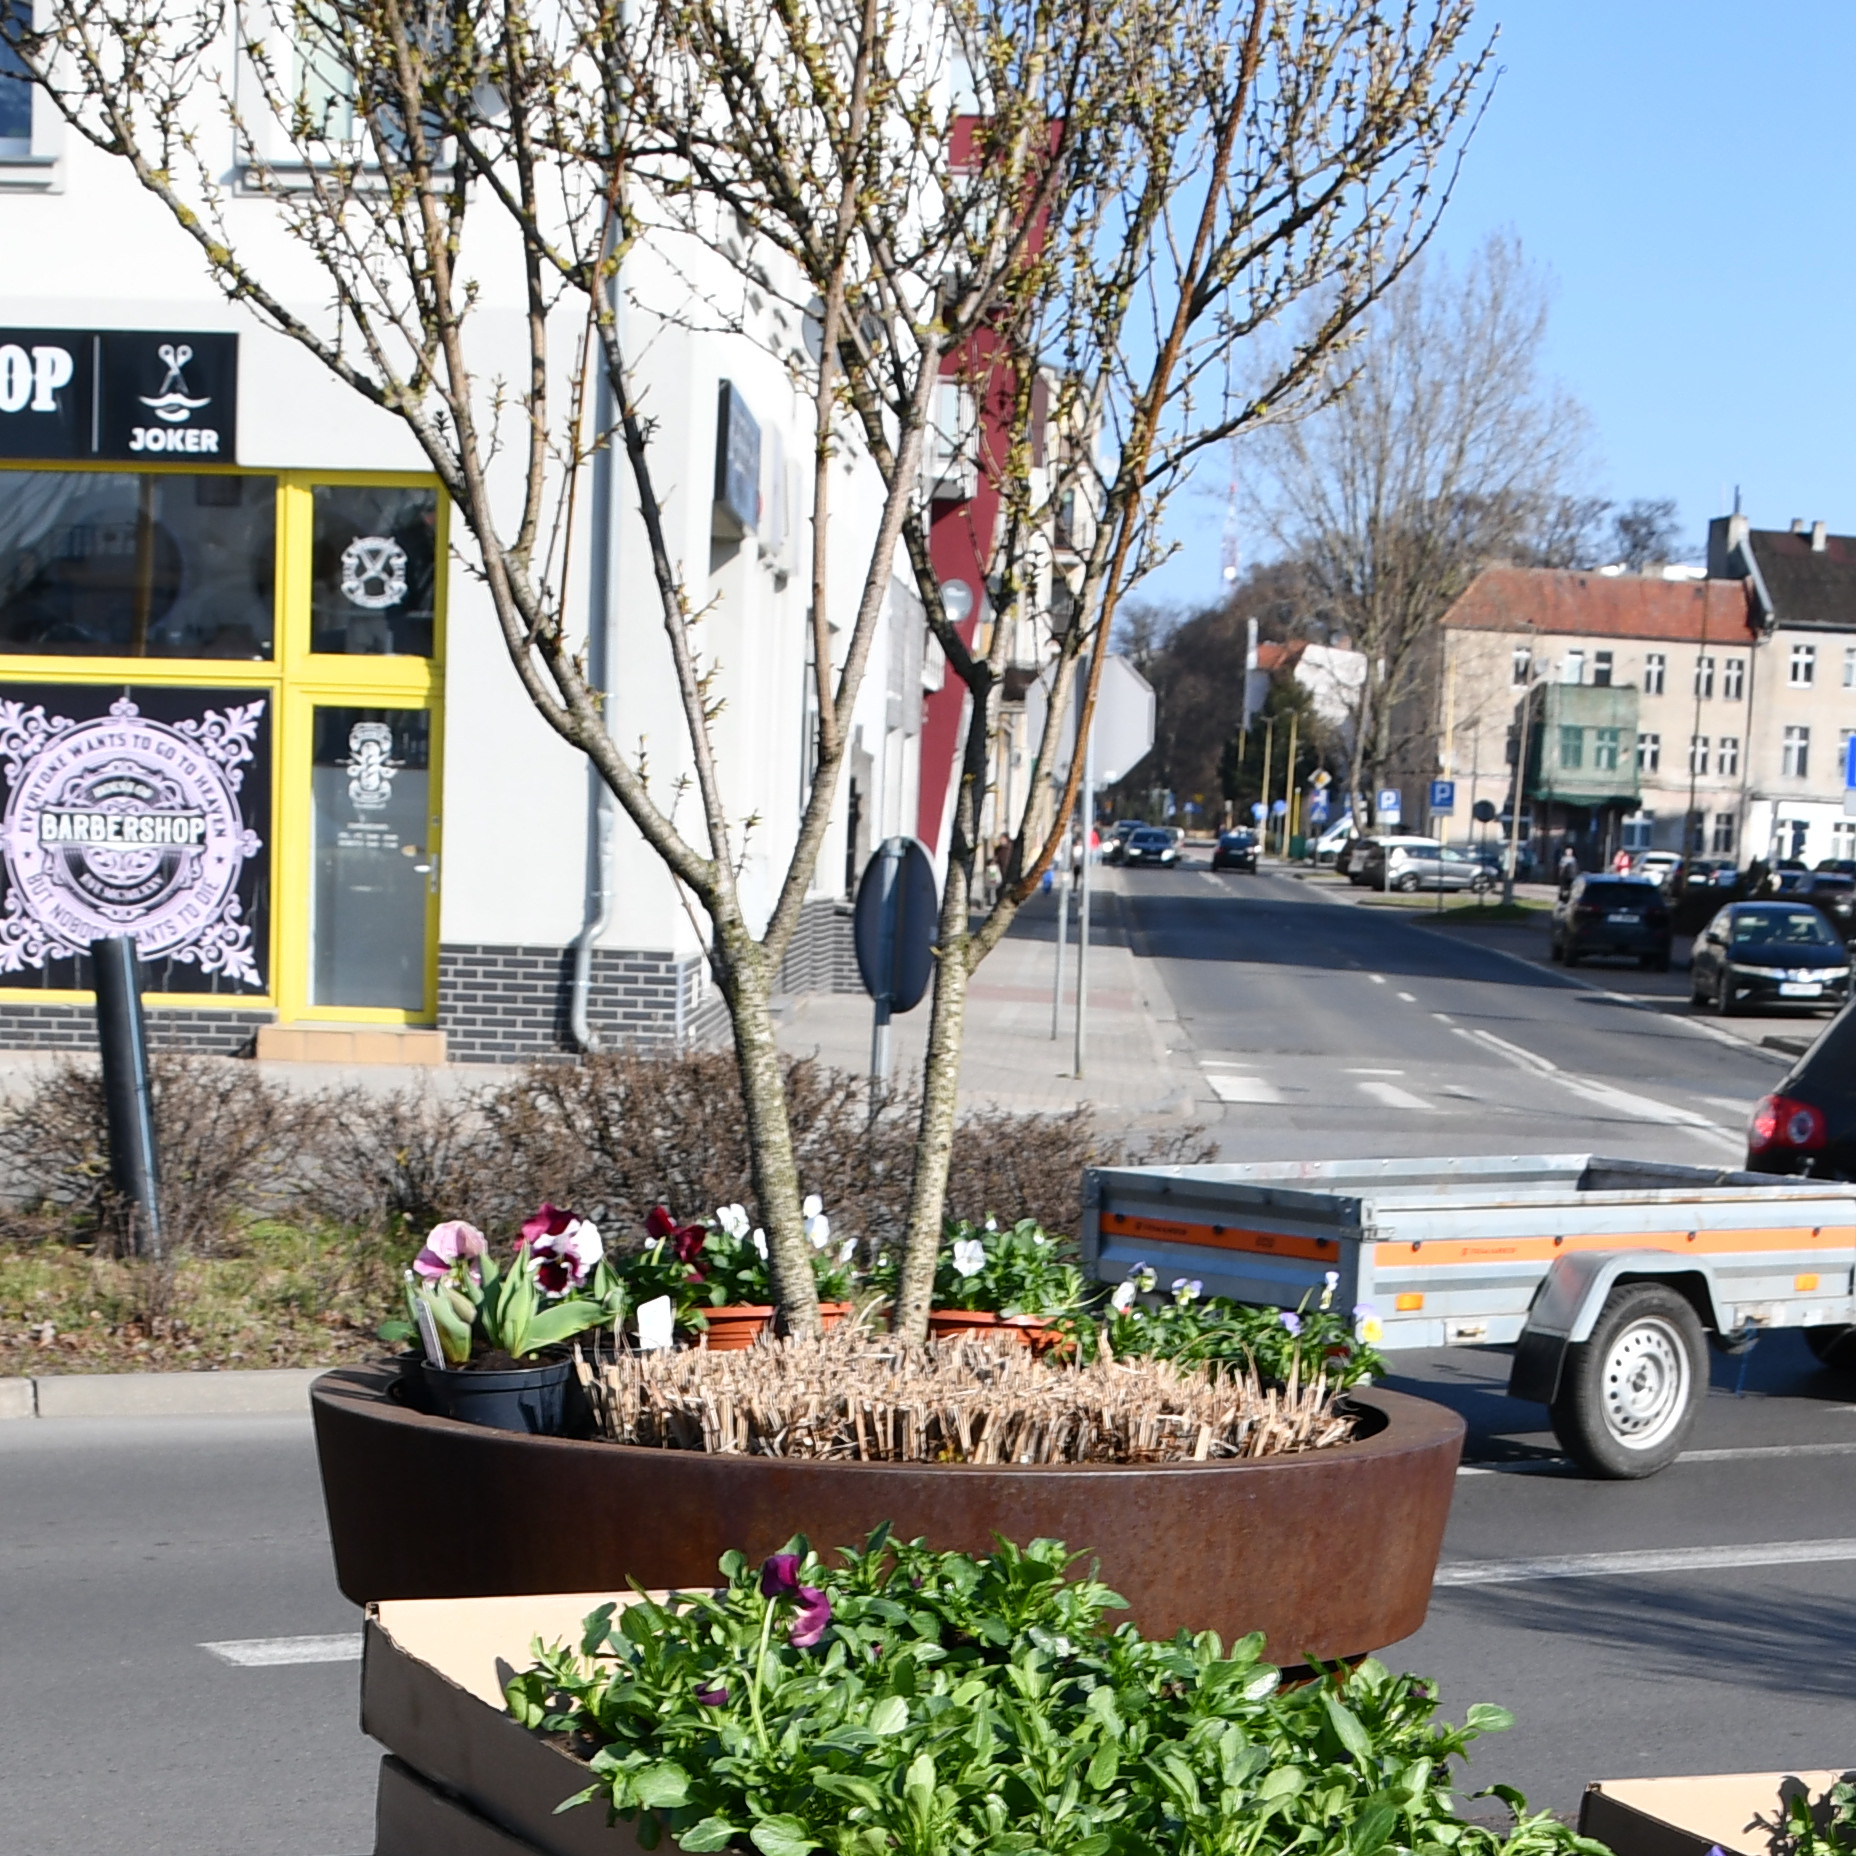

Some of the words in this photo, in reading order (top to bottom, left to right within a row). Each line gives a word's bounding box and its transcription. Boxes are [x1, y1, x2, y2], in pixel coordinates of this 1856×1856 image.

[128, 427, 220, 453] JOKER
[72, 732, 127, 758] WANTS
[133, 734, 152, 750] TO
[155, 741, 175, 761] GO
[178, 754, 197, 776] TO
[195, 774, 228, 838] HEAVEN
[42, 813, 206, 844] BARBERSHOP
[26, 873, 54, 902] BUT
[179, 907, 199, 926] TO
[199, 880, 222, 913] DIE
